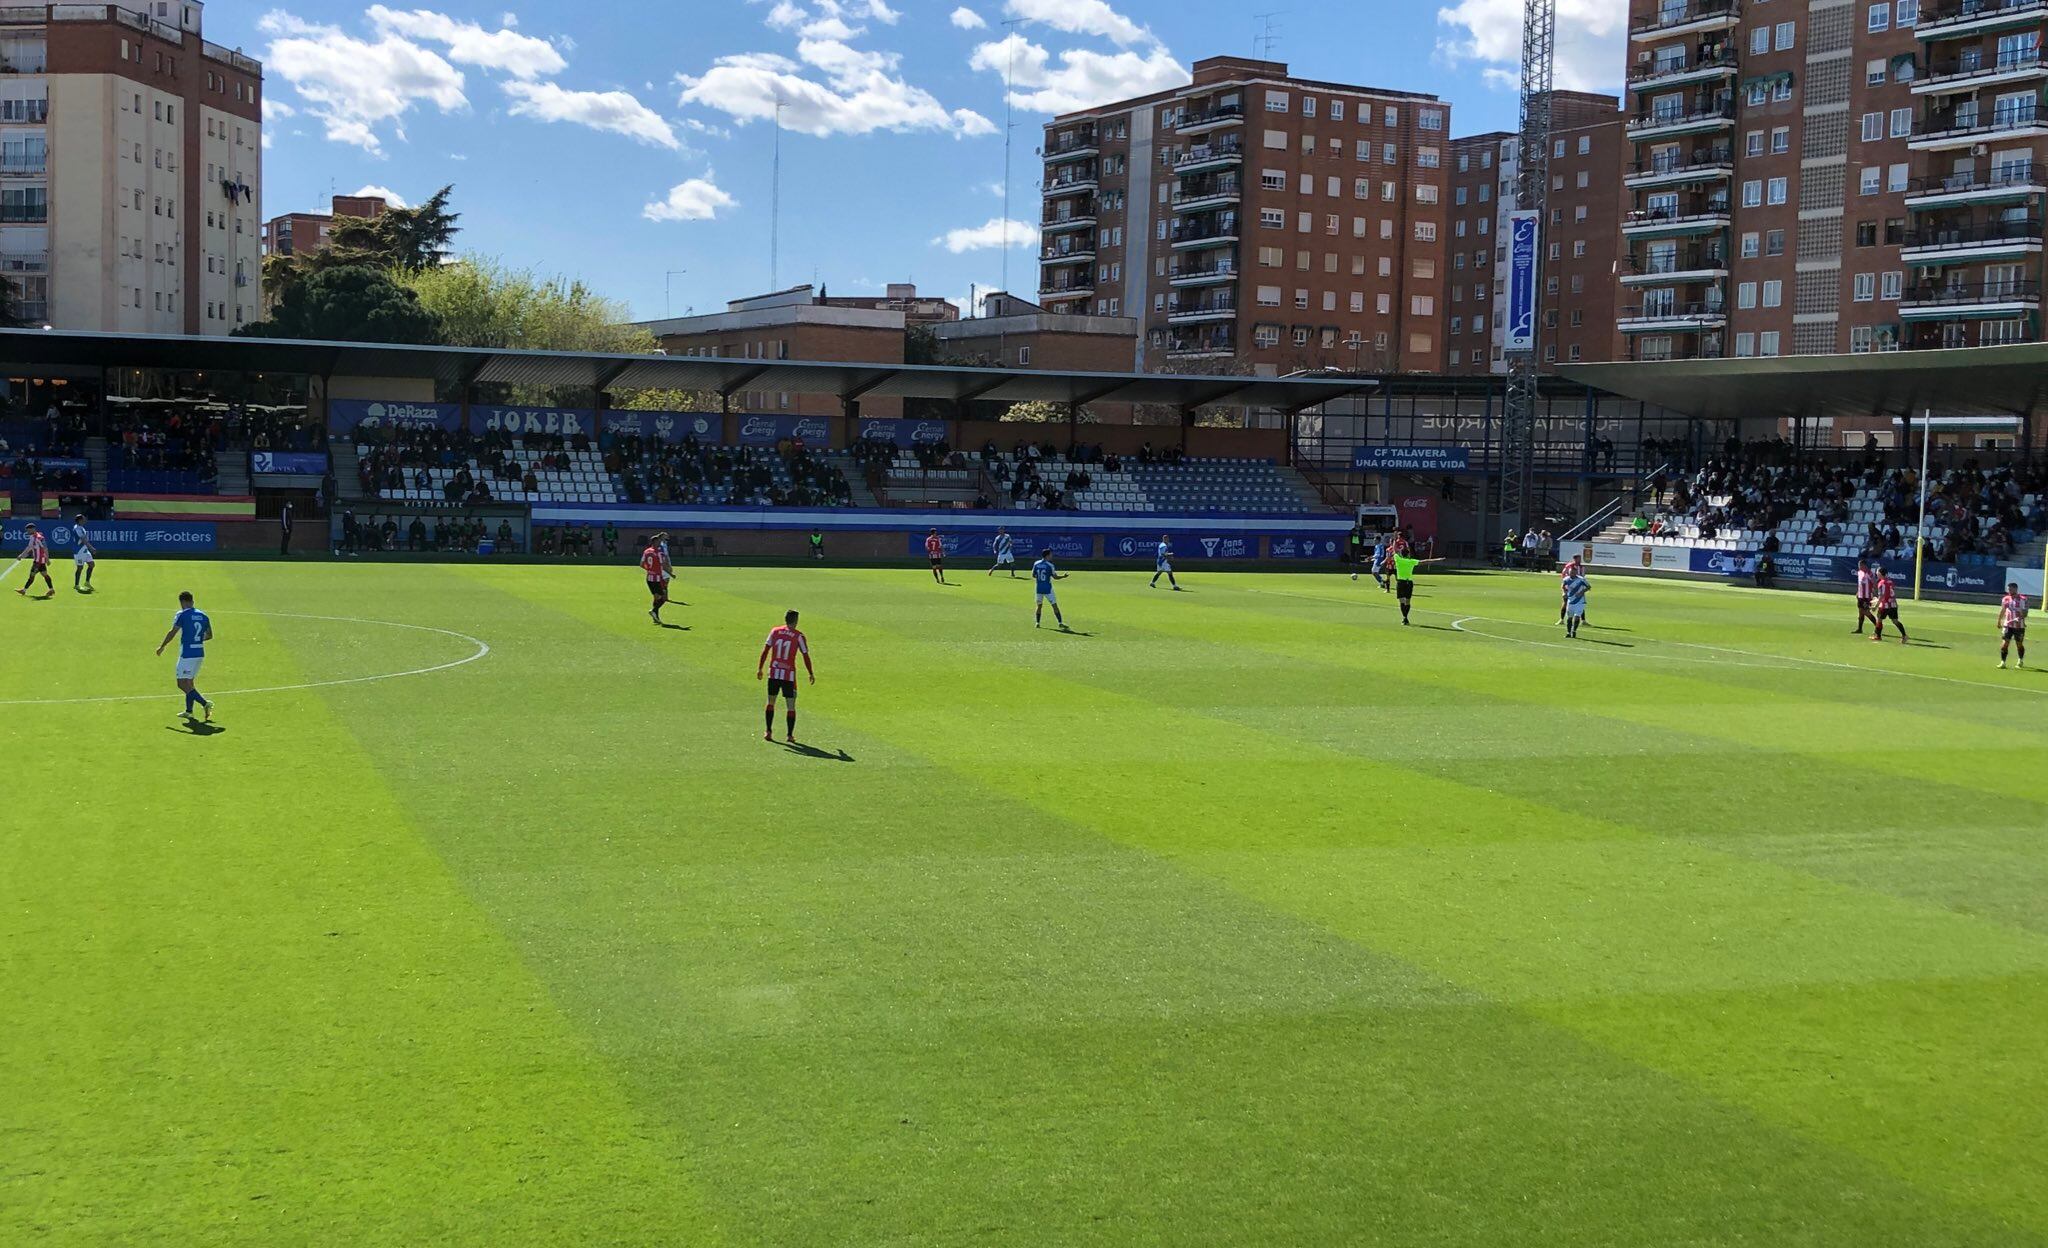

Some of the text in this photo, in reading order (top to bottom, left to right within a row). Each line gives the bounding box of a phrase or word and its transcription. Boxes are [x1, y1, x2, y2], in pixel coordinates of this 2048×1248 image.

[387, 404, 438, 419] DeRaza
[486, 410, 581, 434] JOKER
[1374, 449, 1447, 457] CF TALAVERA
[1381, 460, 1419, 468] FORMA
[1440, 461, 1466, 469] VIDA
[157, 530, 211, 543] Footters
[647, 556, 653, 569] 9
[1036, 569, 1047, 582] 16
[193, 622, 203, 641] 2
[774, 638, 792, 660] 11
